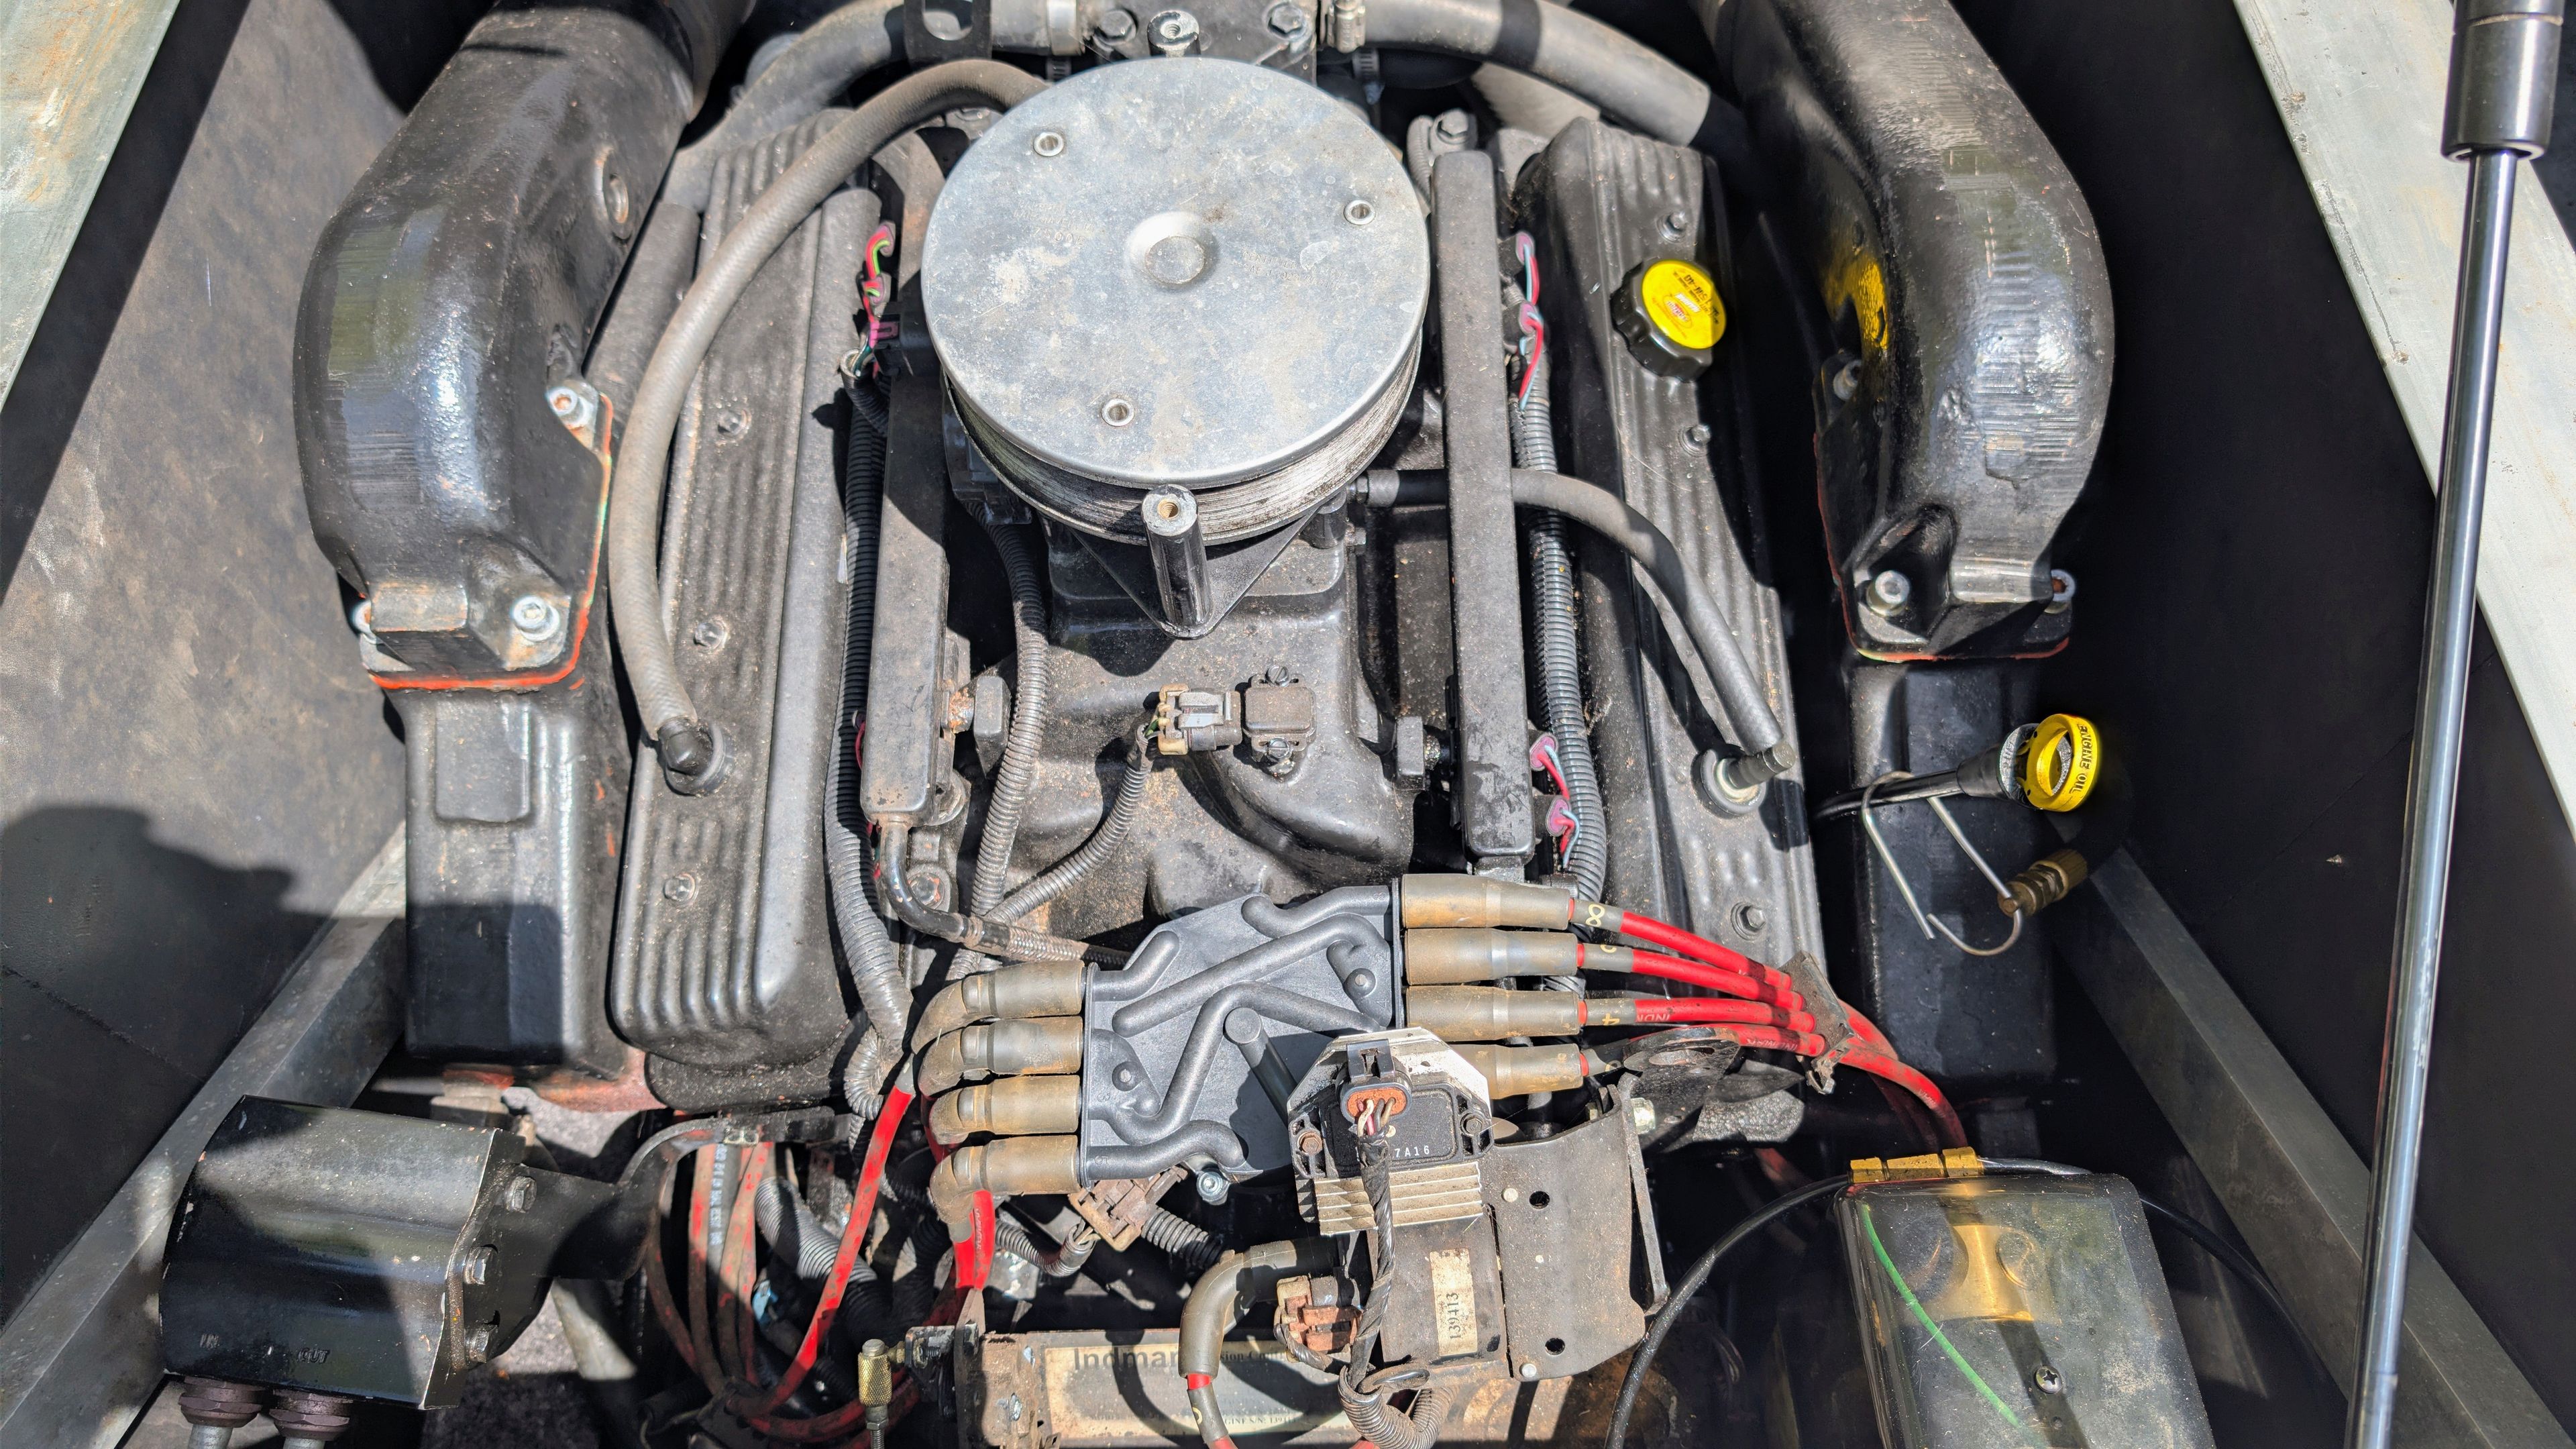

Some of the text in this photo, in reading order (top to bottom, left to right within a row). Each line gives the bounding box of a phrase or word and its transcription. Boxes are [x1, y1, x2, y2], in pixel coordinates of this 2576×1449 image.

[2070, 723, 2093, 794] ENGINE OIL
[1585, 904, 1605, 927] 8
[1447, 1292, 1462, 1341] 139413
[298, 1346, 331, 1364] OUT
